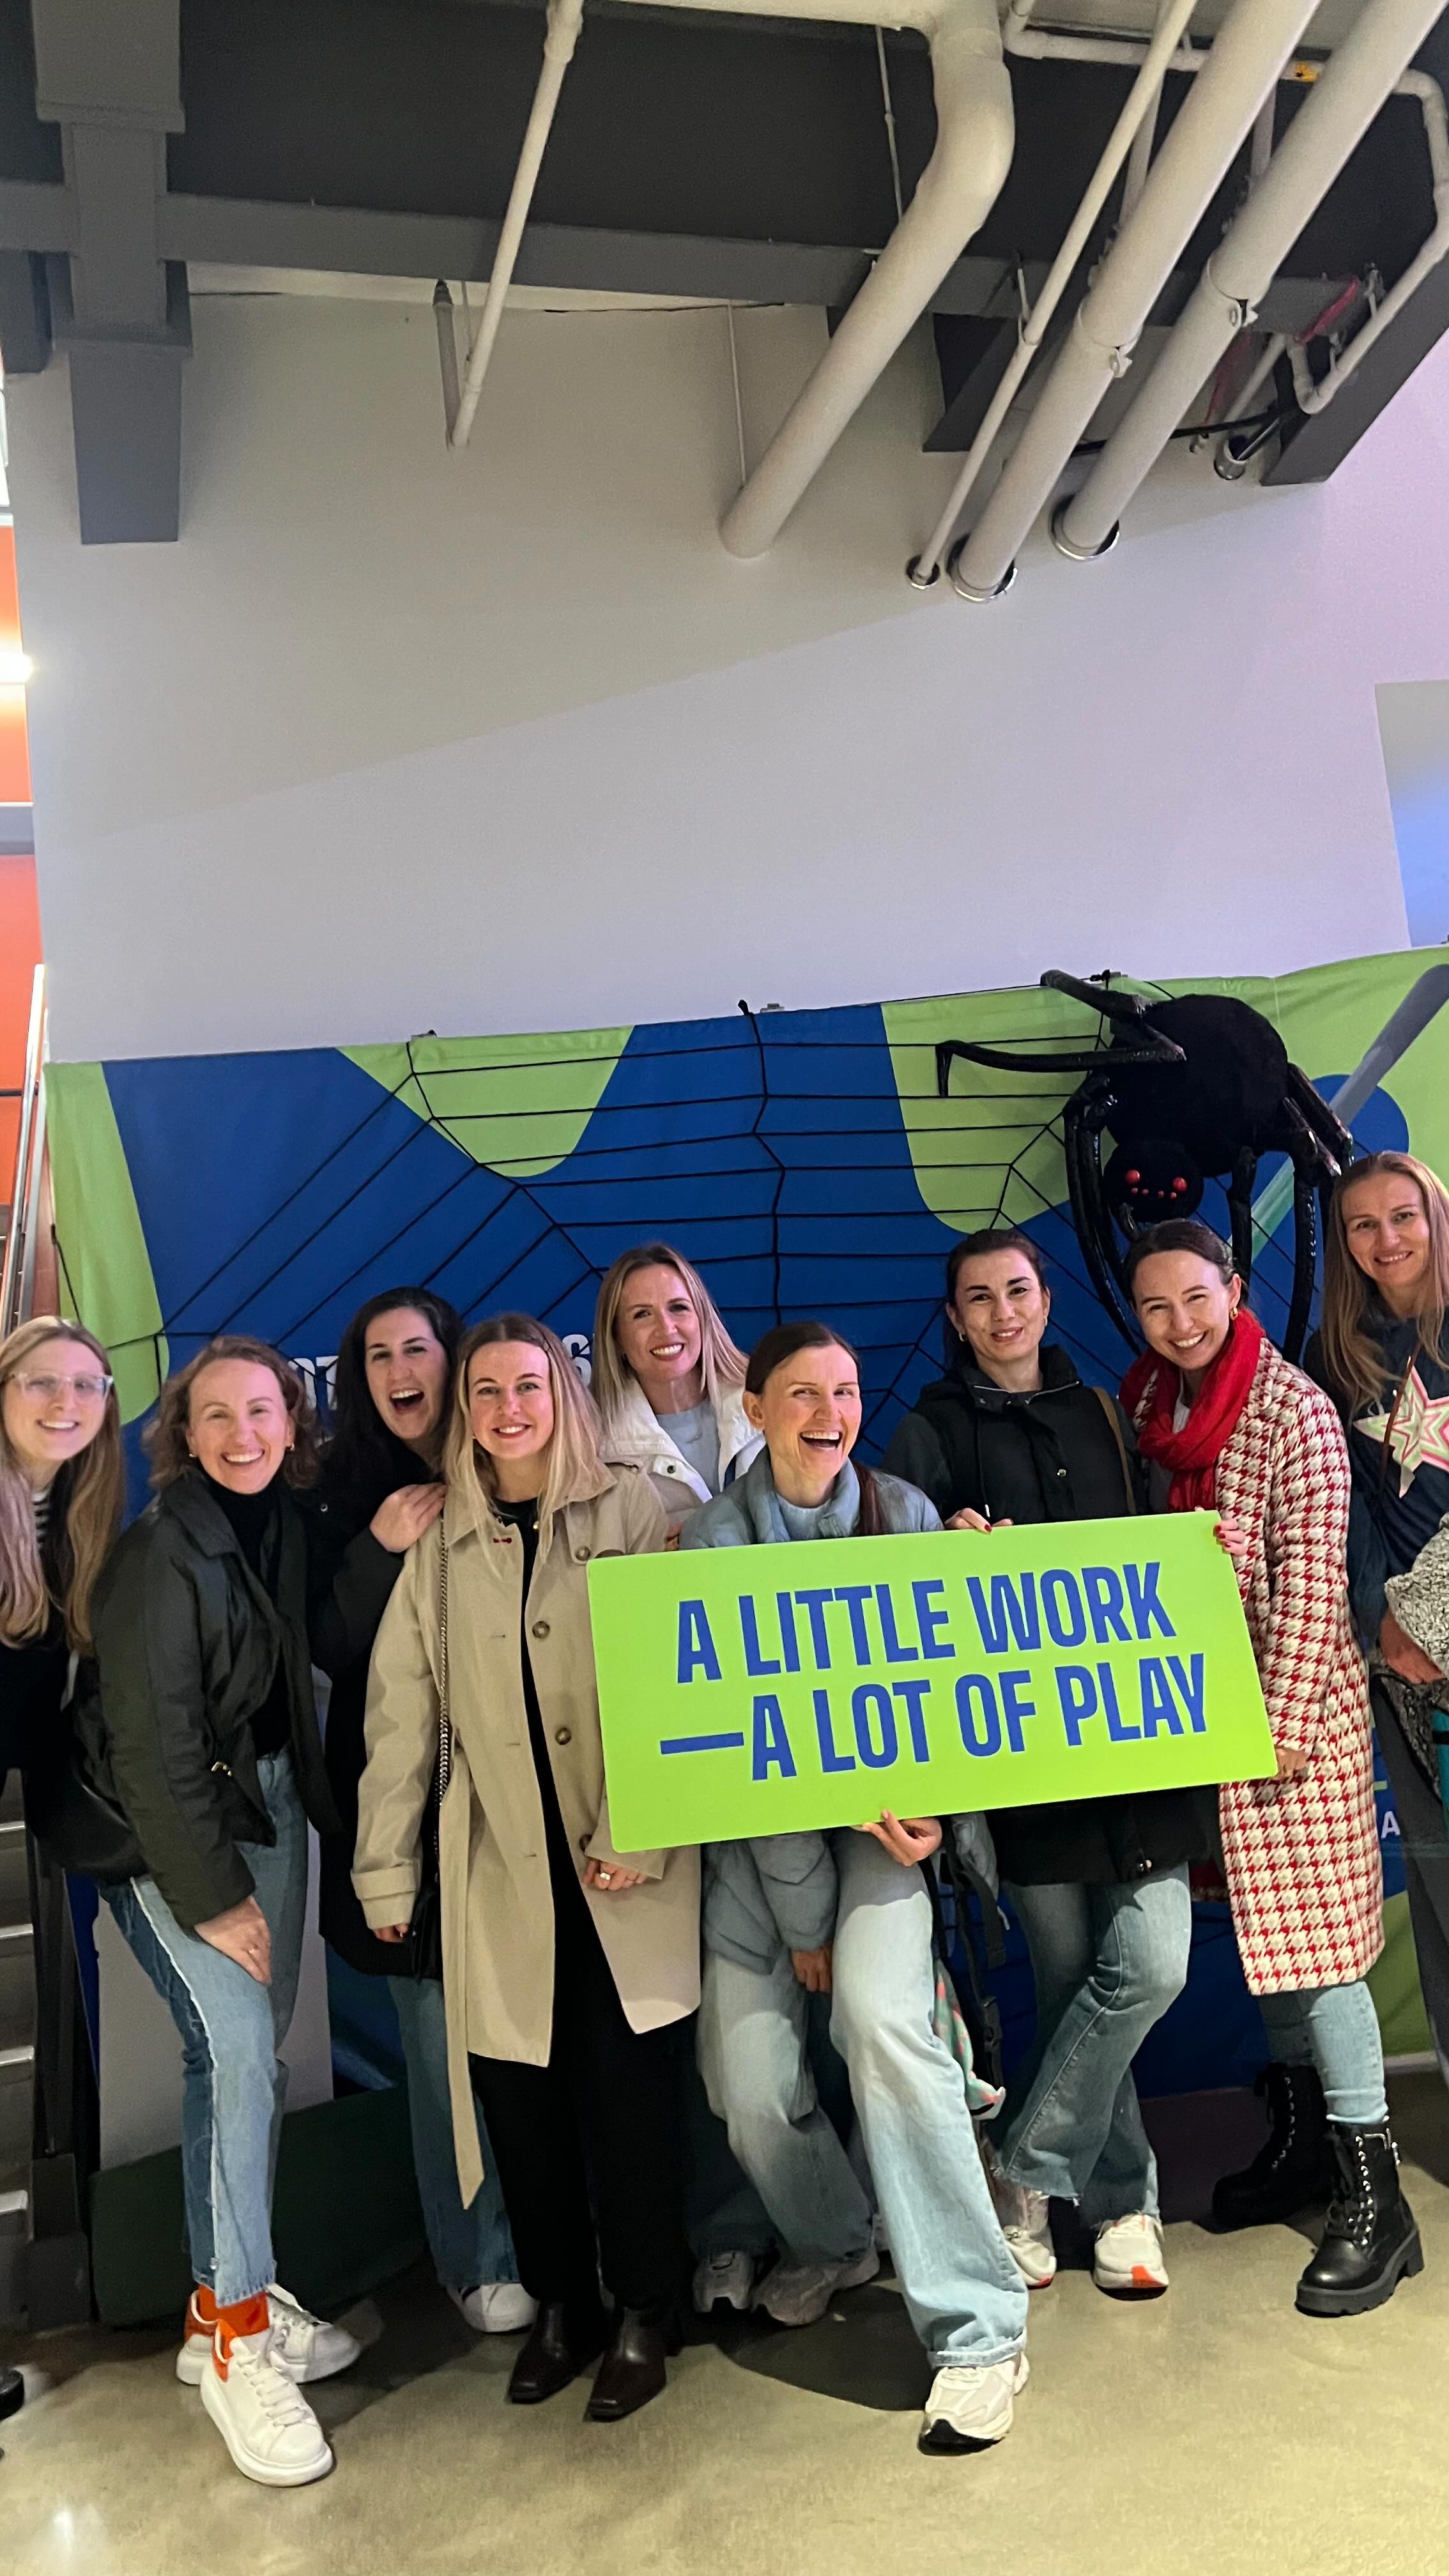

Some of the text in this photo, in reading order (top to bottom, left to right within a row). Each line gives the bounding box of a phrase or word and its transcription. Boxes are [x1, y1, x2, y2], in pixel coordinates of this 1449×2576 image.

[677, 1562, 1176, 1683] A LITTLE WORK
[813, 1680, 931, 1773] LOT
[954, 1670, 1036, 1757] OF
[1055, 1653, 1206, 1746] PLAY
